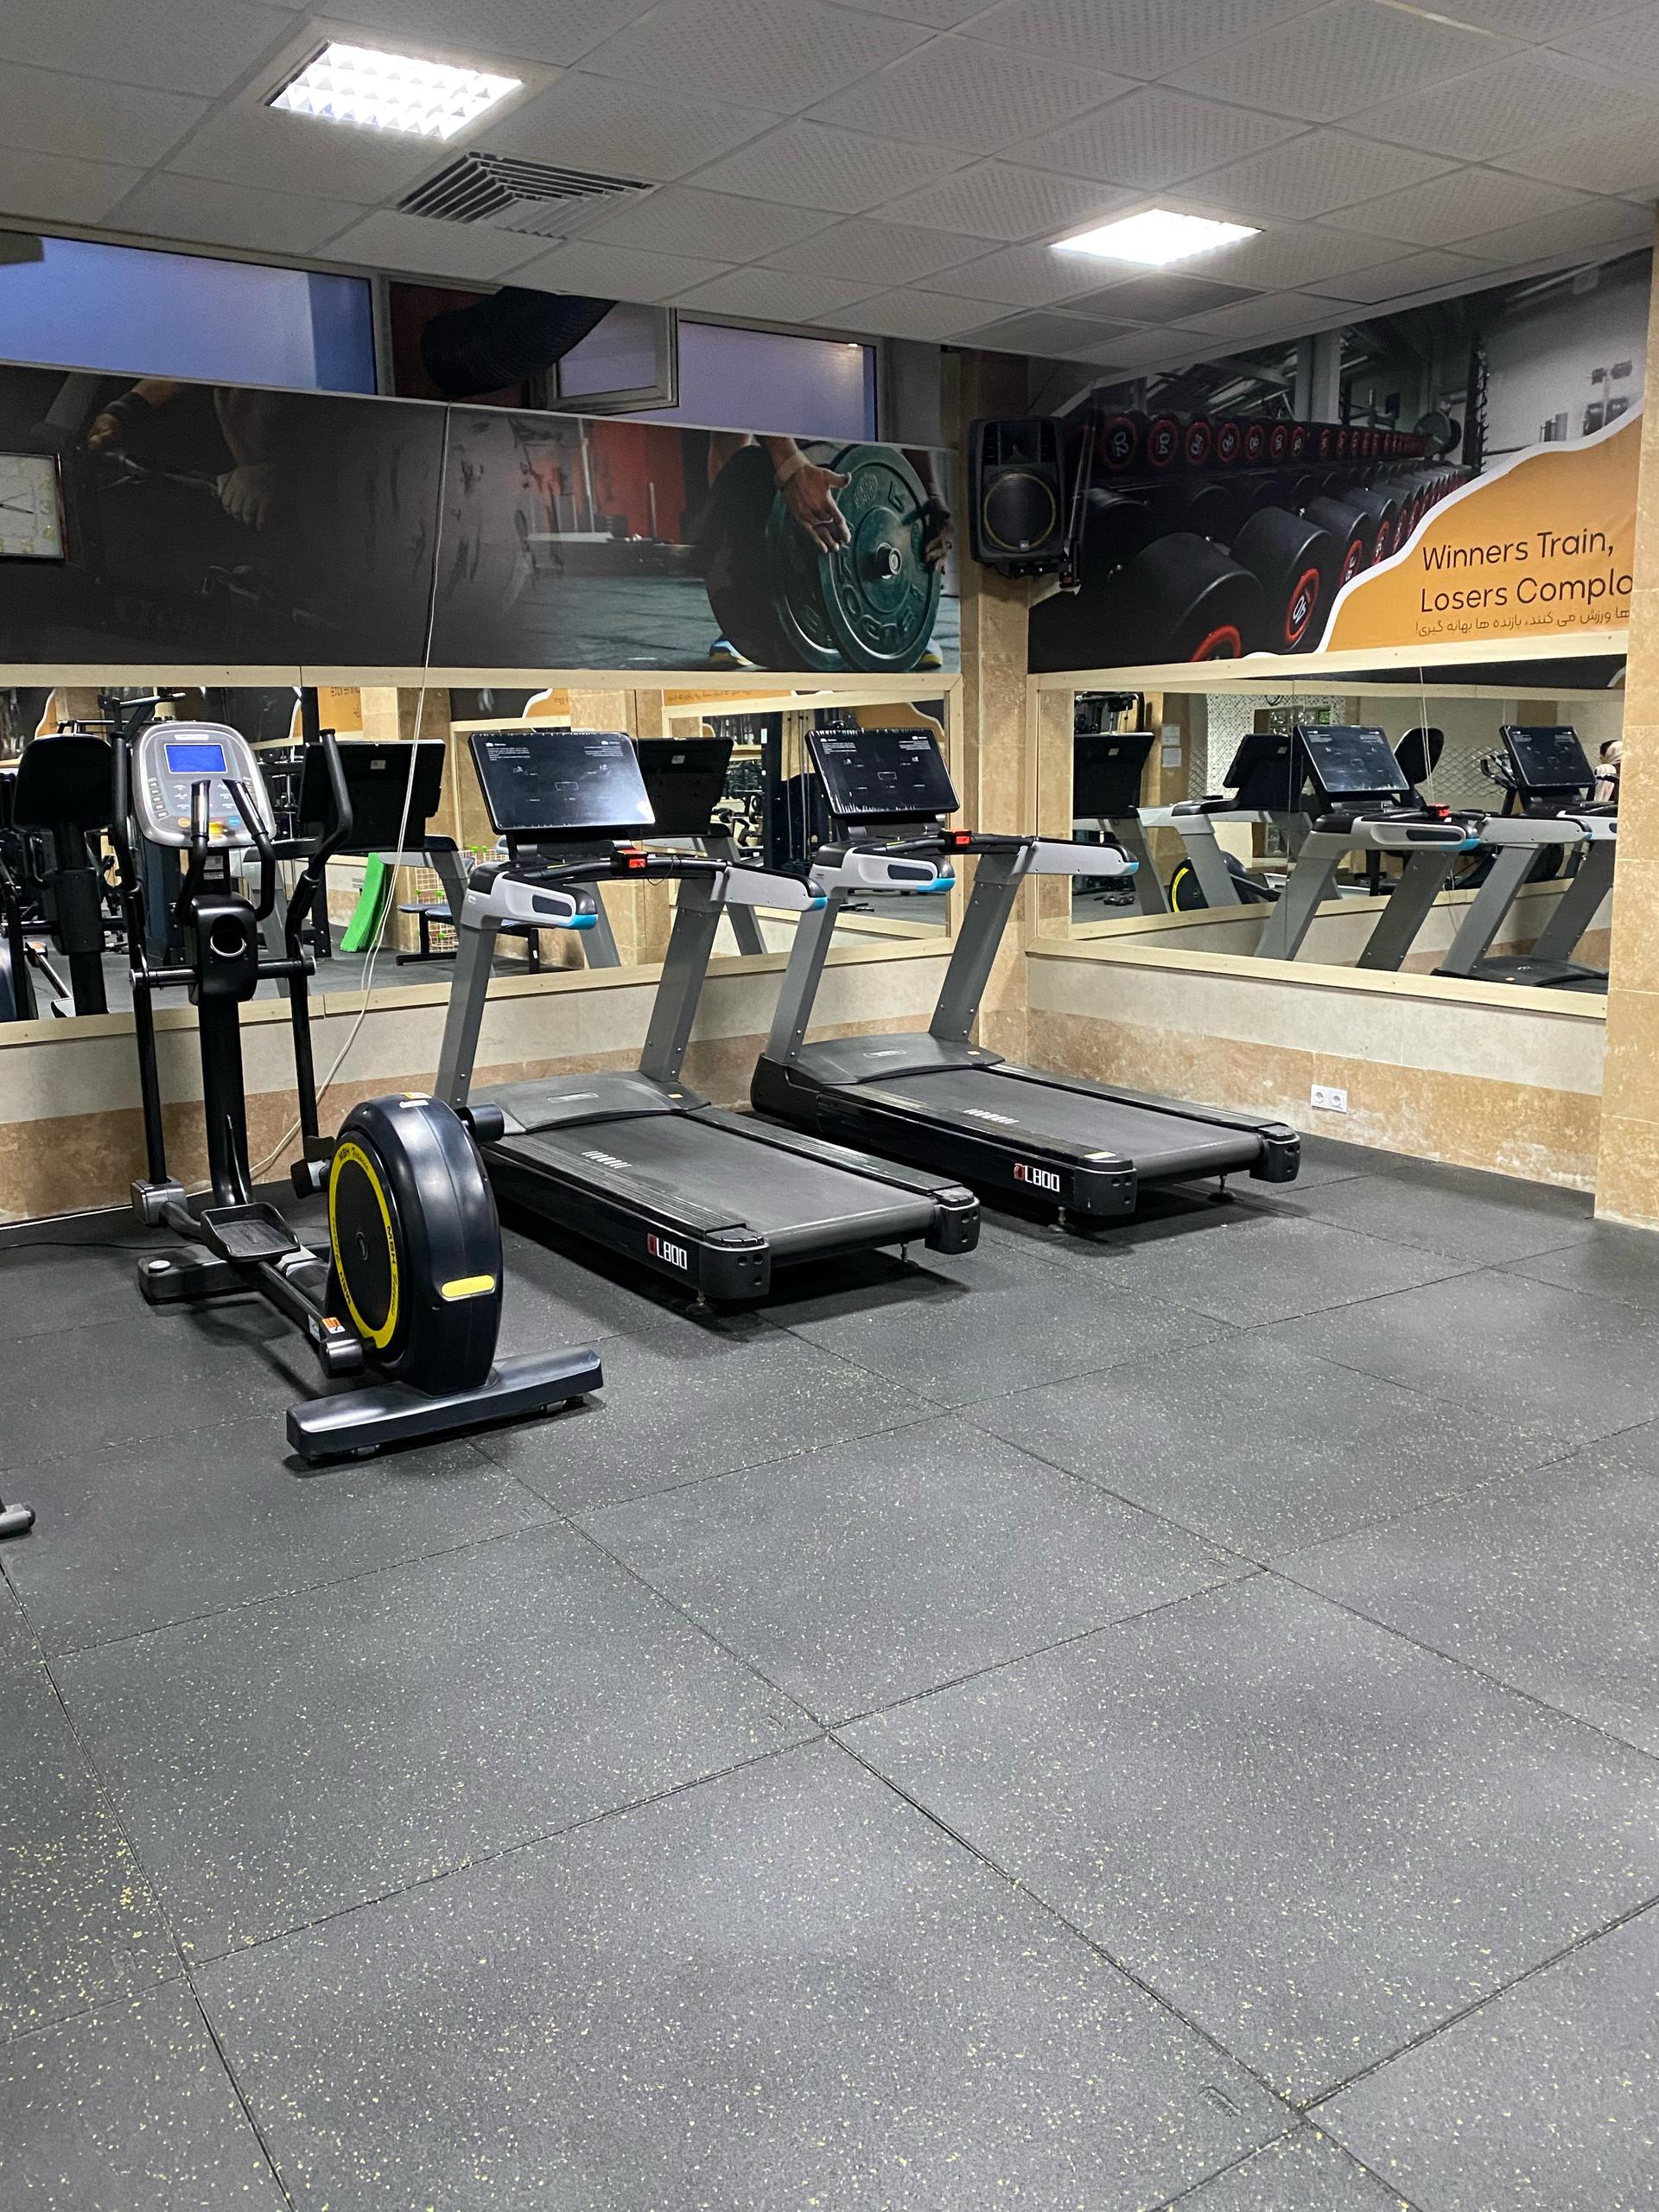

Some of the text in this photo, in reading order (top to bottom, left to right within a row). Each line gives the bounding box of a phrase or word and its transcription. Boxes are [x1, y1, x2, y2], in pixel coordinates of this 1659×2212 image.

[1423, 528, 1613, 570] Winners Train,
[1421, 588, 1508, 612] Losers
[1476, 617, 1490, 629] ها
[1493, 614, 1522, 631] بازنده
[1557, 613, 1576, 626] می
[1580, 608, 1611, 625] ورزش
[1446, 619, 1472, 634] بهانه
[386, 1225, 397, 1264] MBH
